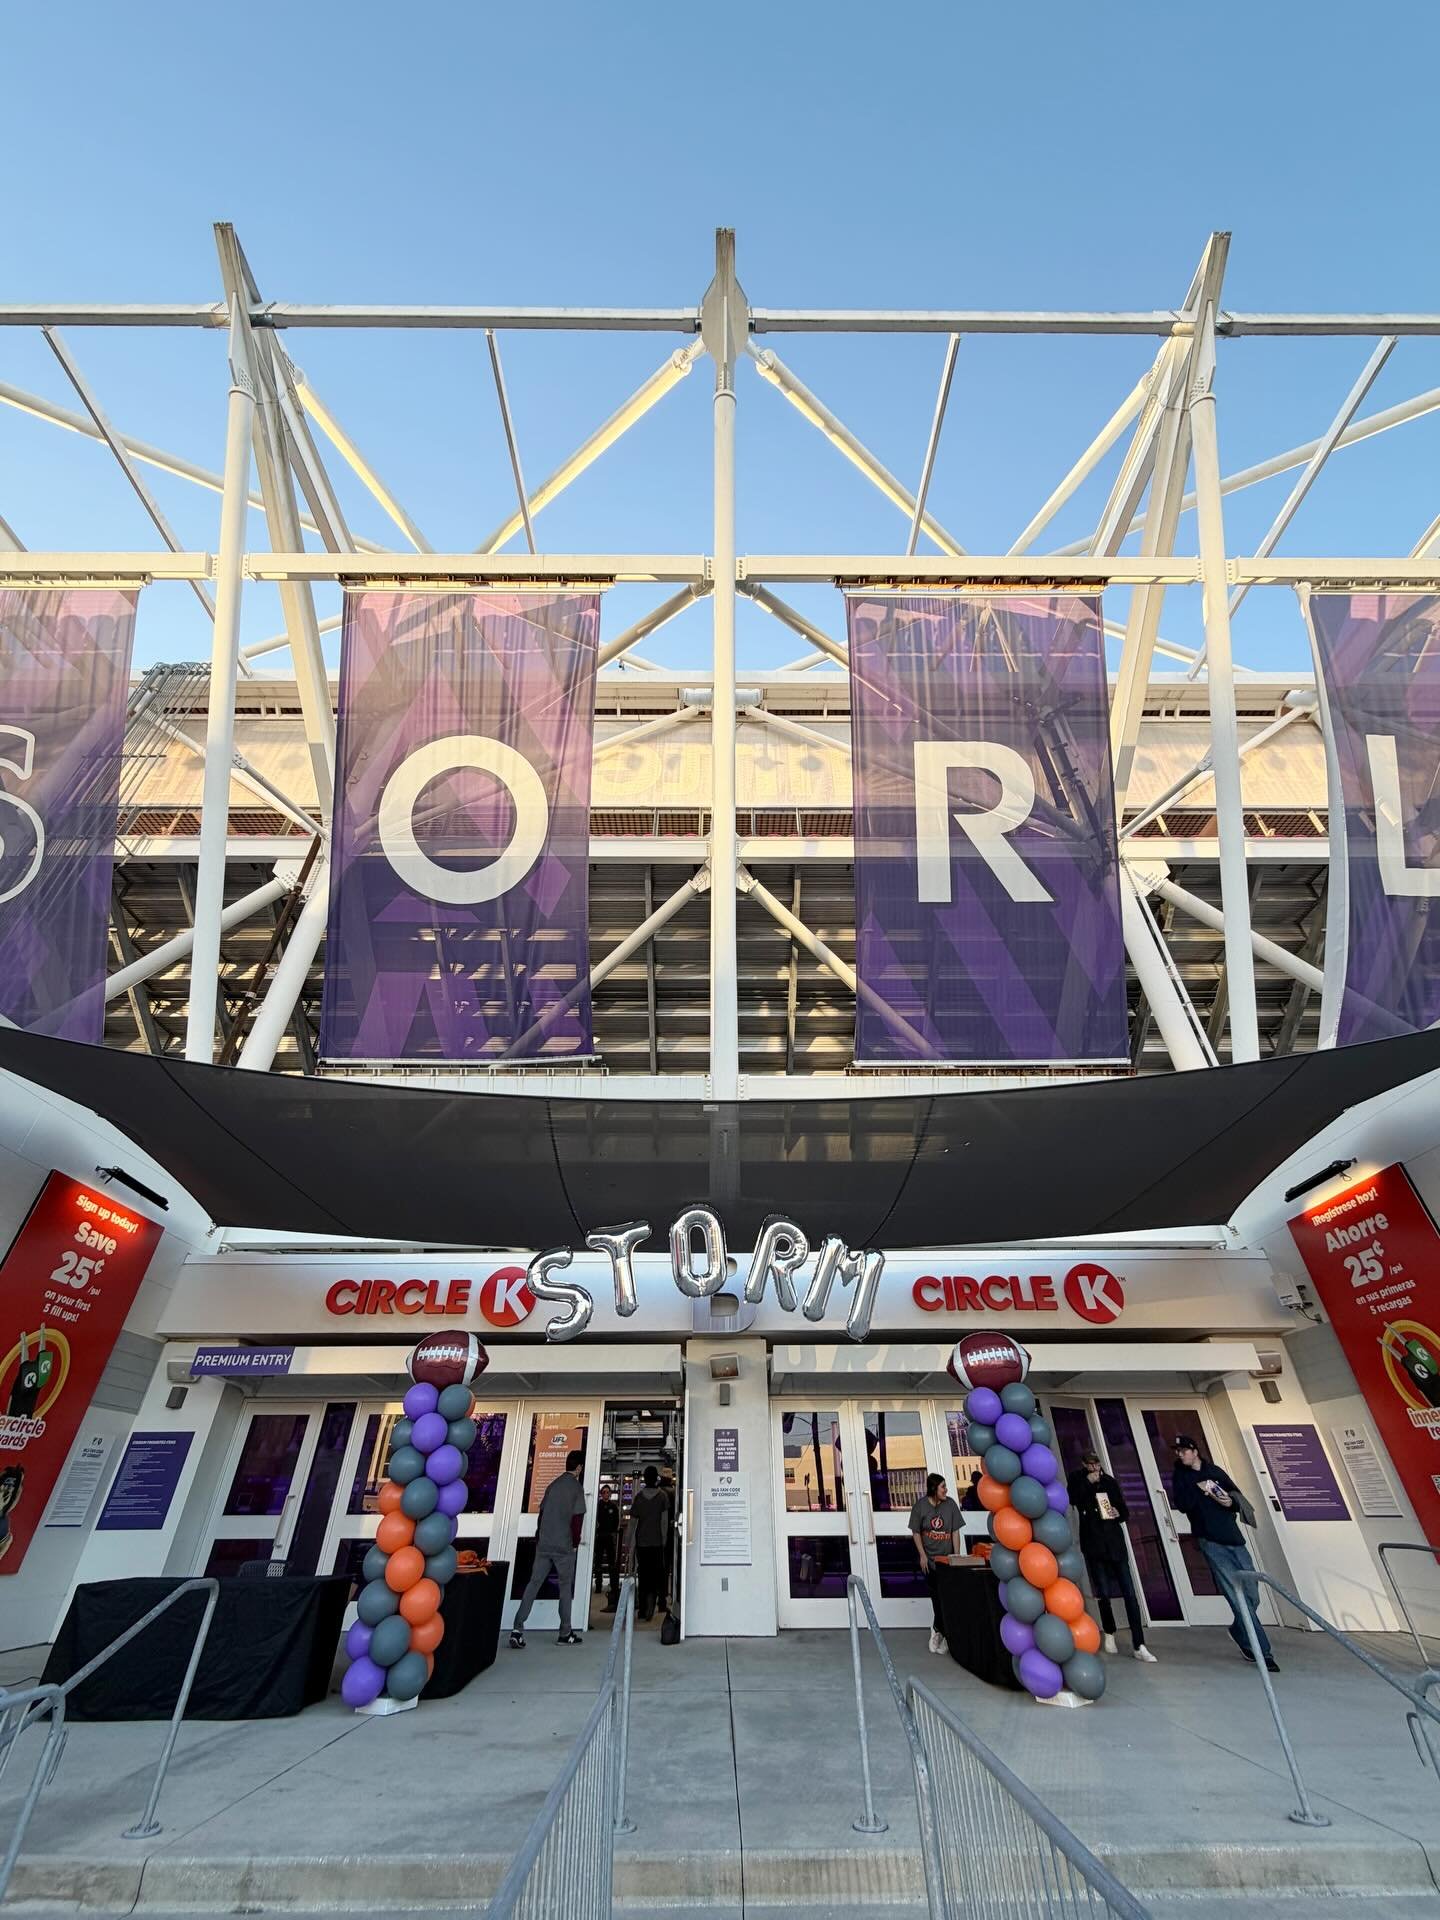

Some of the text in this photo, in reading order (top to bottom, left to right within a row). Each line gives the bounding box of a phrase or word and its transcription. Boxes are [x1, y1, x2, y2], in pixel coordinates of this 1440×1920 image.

[378, 735, 549, 904] O
[913, 741, 1054, 902] R
[1355, 1187, 1378, 1204] hoy!
[76, 1195, 138, 1233] Sign up today!
[74, 1222, 117, 1255] Save
[1325, 1213, 1389, 1253] Ahorre
[531, 1204, 885, 1343] STORM
[44, 1290, 91, 1311] on your first
[326, 1274, 532, 1323] CIRCLE K
[912, 1276, 1059, 1312] CIRCLE
[1071, 1269, 1124, 1321] K
[1356, 1279, 1416, 1305] en sus primeras
[1370, 1295, 1412, 1315] 5 recargas
[43, 1304, 79, 1322] 5 fill ups!
[195, 1354, 291, 1366] PREMIUM ENTRY
